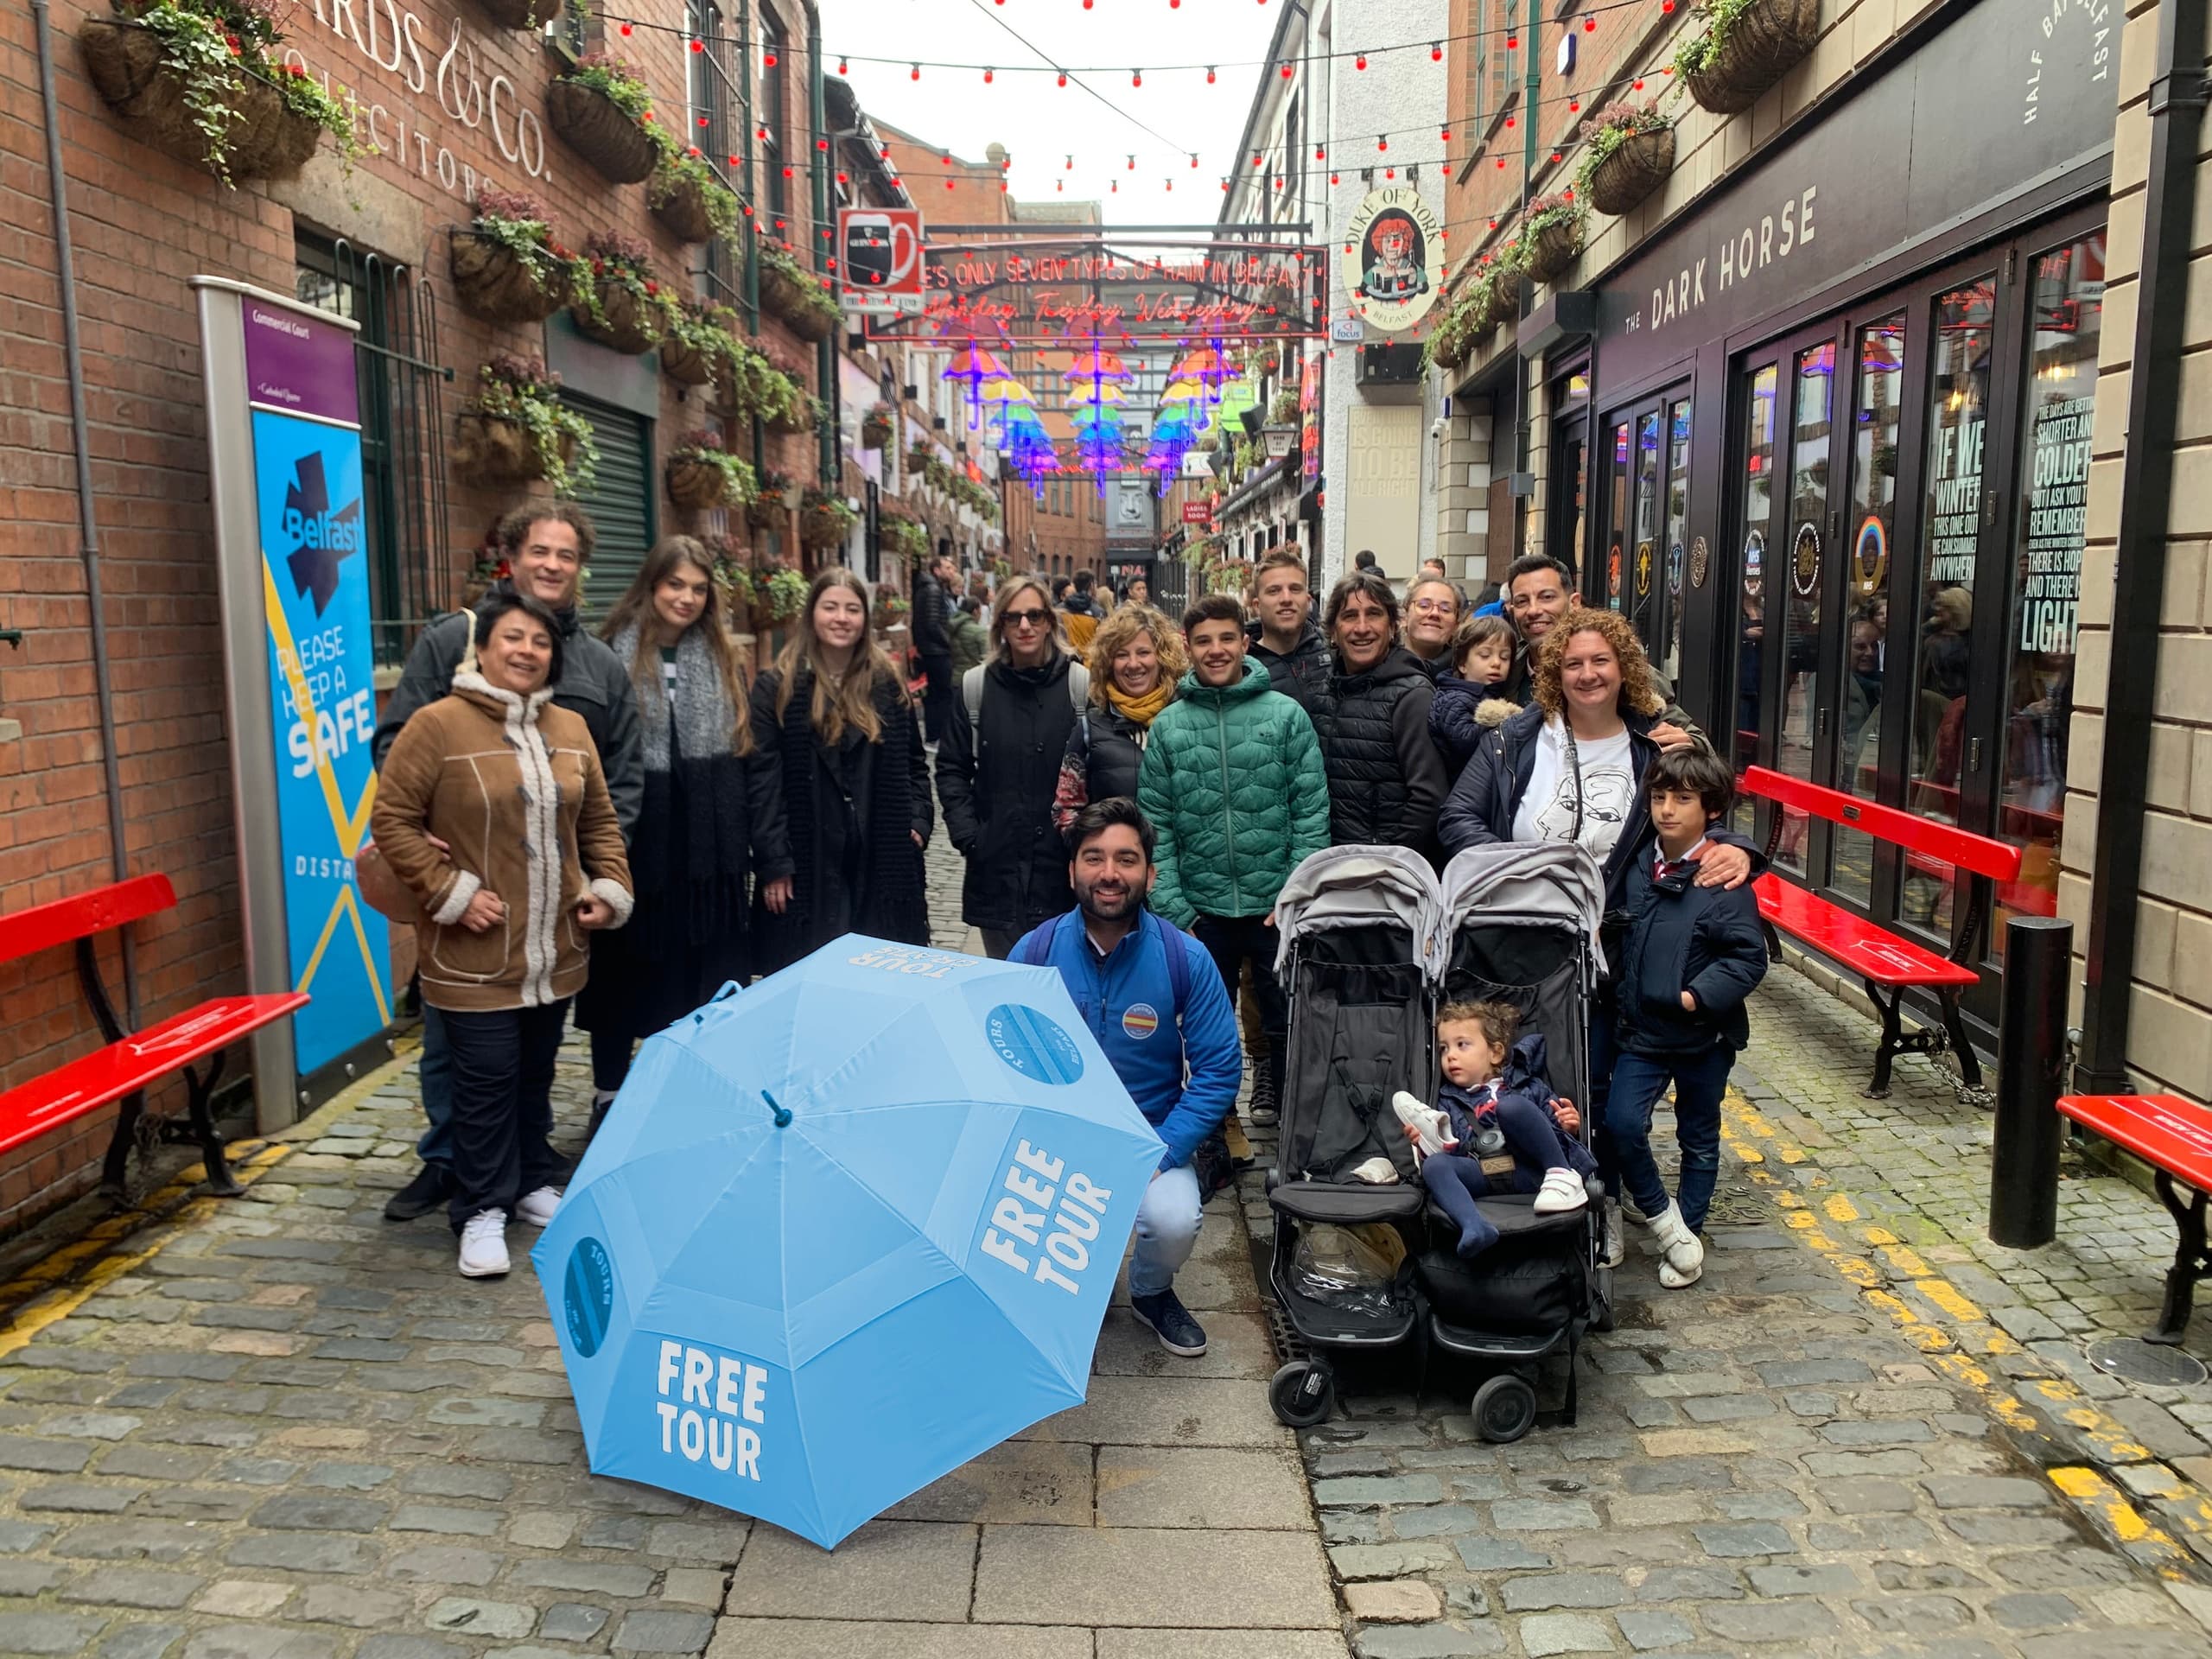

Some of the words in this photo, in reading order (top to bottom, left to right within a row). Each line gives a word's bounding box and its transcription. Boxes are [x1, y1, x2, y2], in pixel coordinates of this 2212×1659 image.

[2023, 49, 2044, 125] HALF
[1345, 196, 1379, 245] DUKE
[1382, 187, 1405, 205] OF
[1410, 198, 1441, 245] YORK
[955, 261, 998, 286] ONLY
[1006, 258, 1064, 283] SEVEN
[1071, 257, 1127, 282] TYPES
[1132, 259, 1156, 282] OF
[1211, 261, 1229, 284] IN
[1625, 310, 1641, 335] THE
[1651, 257, 1707, 331] DARK
[1719, 184, 1817, 291] HORSE
[251, 308, 291, 334] Commercial
[291, 322, 310, 340] Court
[1336, 327, 1361, 339] focus
[1371, 309, 1414, 325] BELFAST
[2039, 405, 2050, 421] THE
[2050, 402, 2063, 418] DAYS
[2064, 399, 2075, 415] ARE
[1351, 424, 1370, 448] IS
[1371, 424, 1418, 448] GOING
[2037, 416, 2077, 447] SHORTER
[1352, 446, 1382, 479] TO
[1389, 446, 1418, 479] BE
[1936, 426, 1956, 480] IF
[1957, 419, 1986, 476] WE
[1351, 478, 1374, 499] ALL
[1377, 478, 1418, 499] RIGHT
[2031, 489, 2046, 509] BUT
[2046, 488, 2050, 507] I
[2050, 486, 2065, 507] ASK
[2066, 485, 2082, 505] YOU
[2082, 484, 2088, 504] T
[286, 506, 359, 551] Belfast
[1934, 516, 1949, 537] THIS
[1949, 515, 1965, 536] ONE
[1964, 513, 1979, 535] OUT
[1932, 538, 1942, 556] WE
[1941, 537, 1954, 555] CAN
[2028, 551, 2053, 573] THERE
[2053, 550, 2063, 572] IS
[2063, 550, 2082, 572] HOP
[2024, 575, 2044, 598] AND
[2045, 575, 2074, 598] THERE
[276, 625, 346, 682] PLEASE
[282, 671, 331, 720] KEEP
[334, 664, 347, 696] A
[287, 688, 375, 779] SAFE
[295, 855, 353, 880] DISTA
[847, 951, 953, 979] TOUR
[990, 1018, 1023, 1070] TOURS
[979, 1138, 1066, 1274] FREE
[1033, 1171, 1114, 1296] TOUR
[657, 1339, 769, 1425] FREE
[655, 1401, 762, 1483] TOUR
